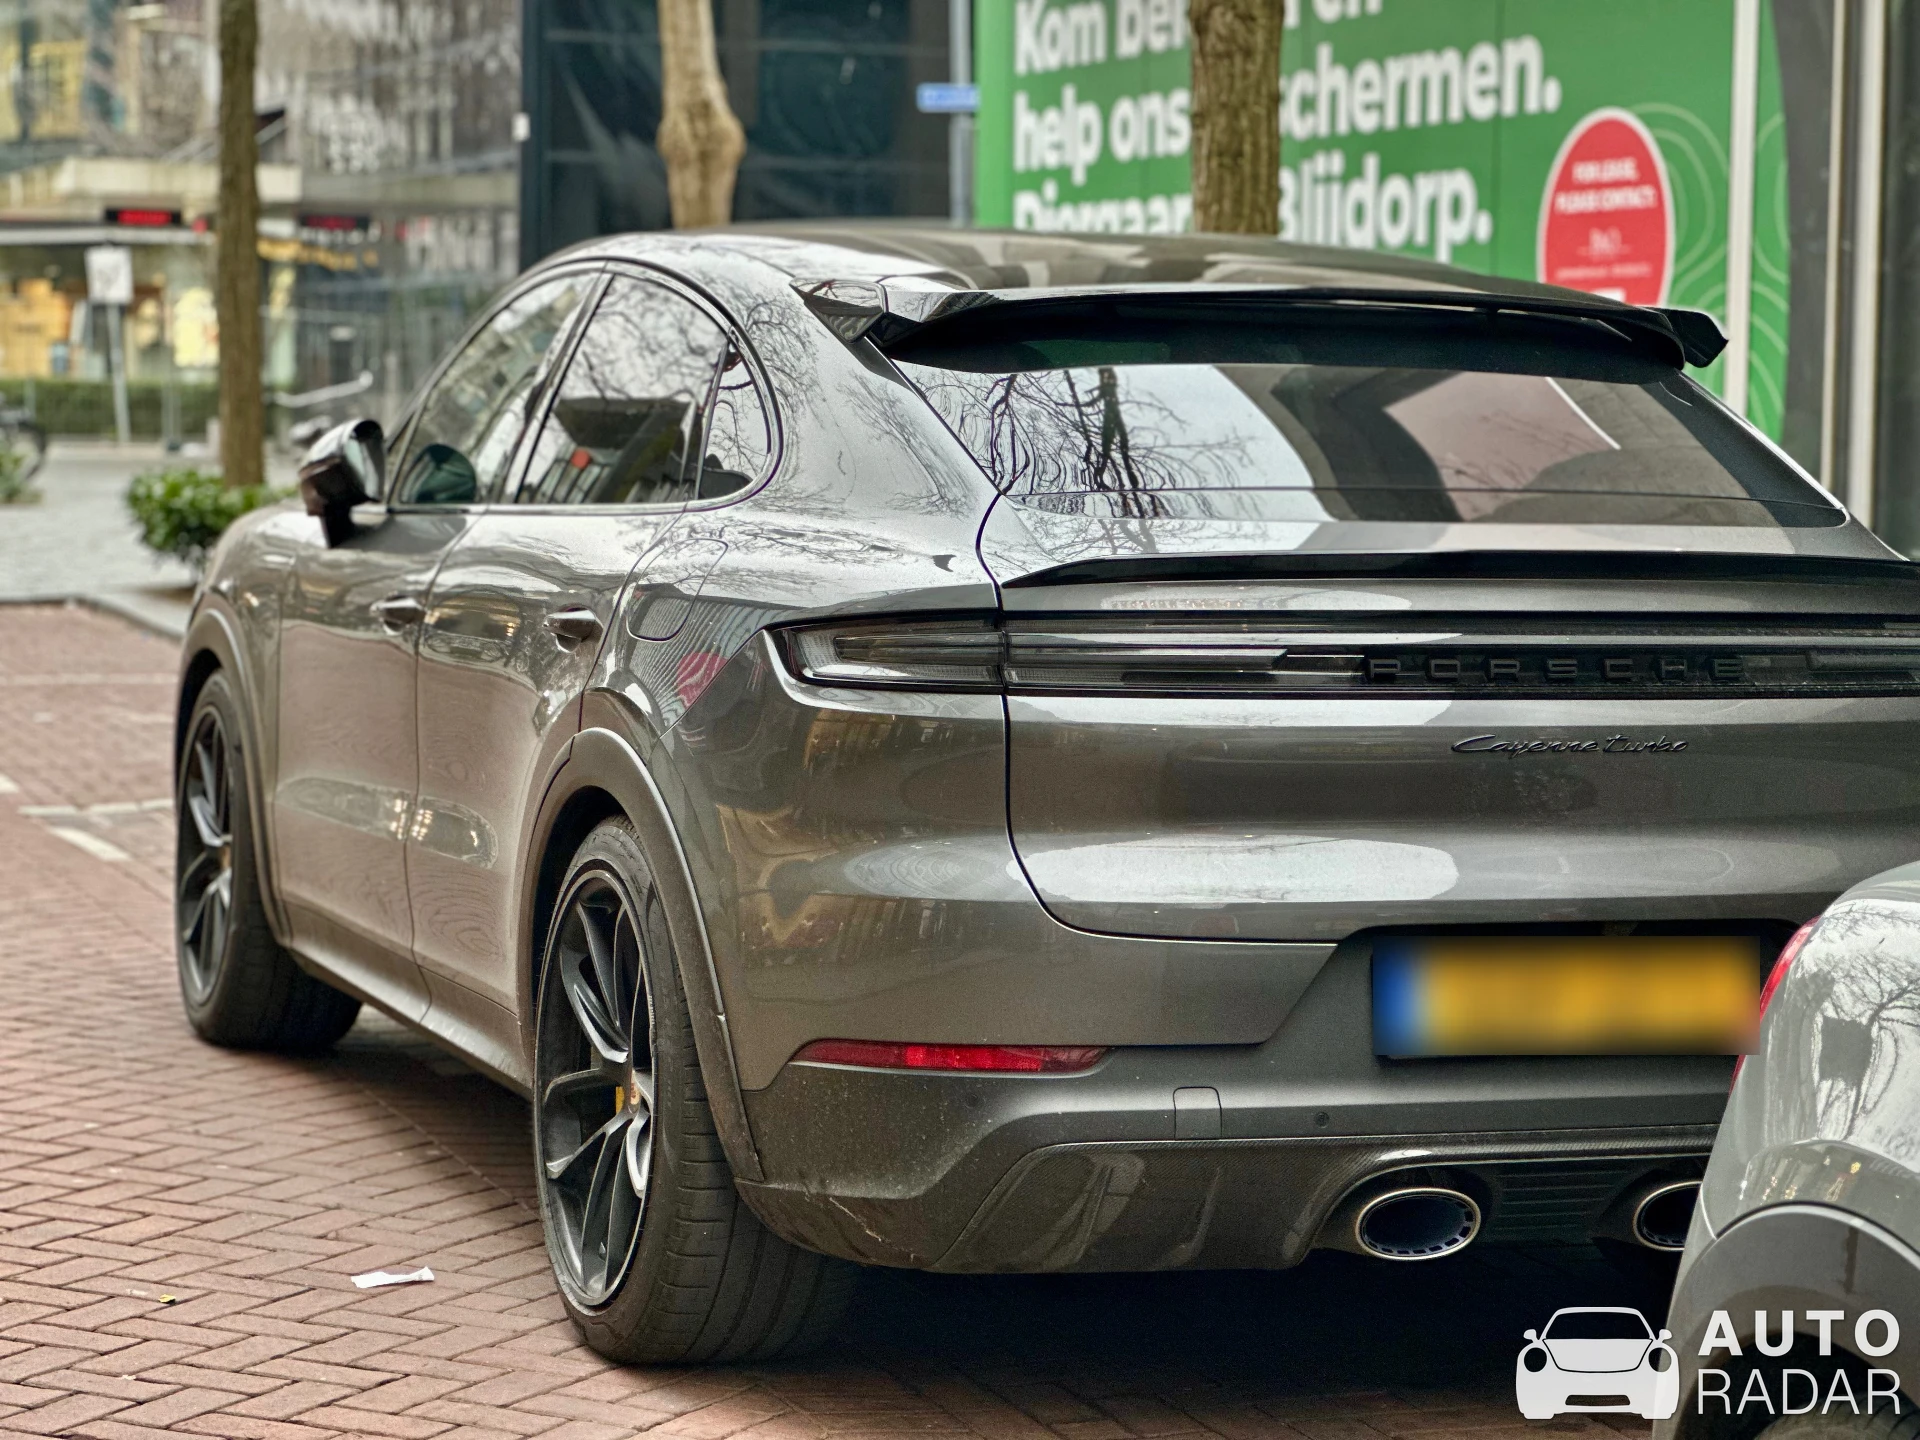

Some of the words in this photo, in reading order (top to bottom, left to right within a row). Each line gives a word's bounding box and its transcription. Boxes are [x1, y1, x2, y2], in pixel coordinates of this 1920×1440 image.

[1014, 0, 1107, 76] Kom
[1014, 82, 1103, 187] help
[1109, 88, 1192, 162] ons
[1279, 36, 1562, 142] chermen.
[1368, 657, 1743, 679] PORSCHE
[1451, 733, 1599, 757] Cayenne
[1603, 733, 1688, 753] turbo
